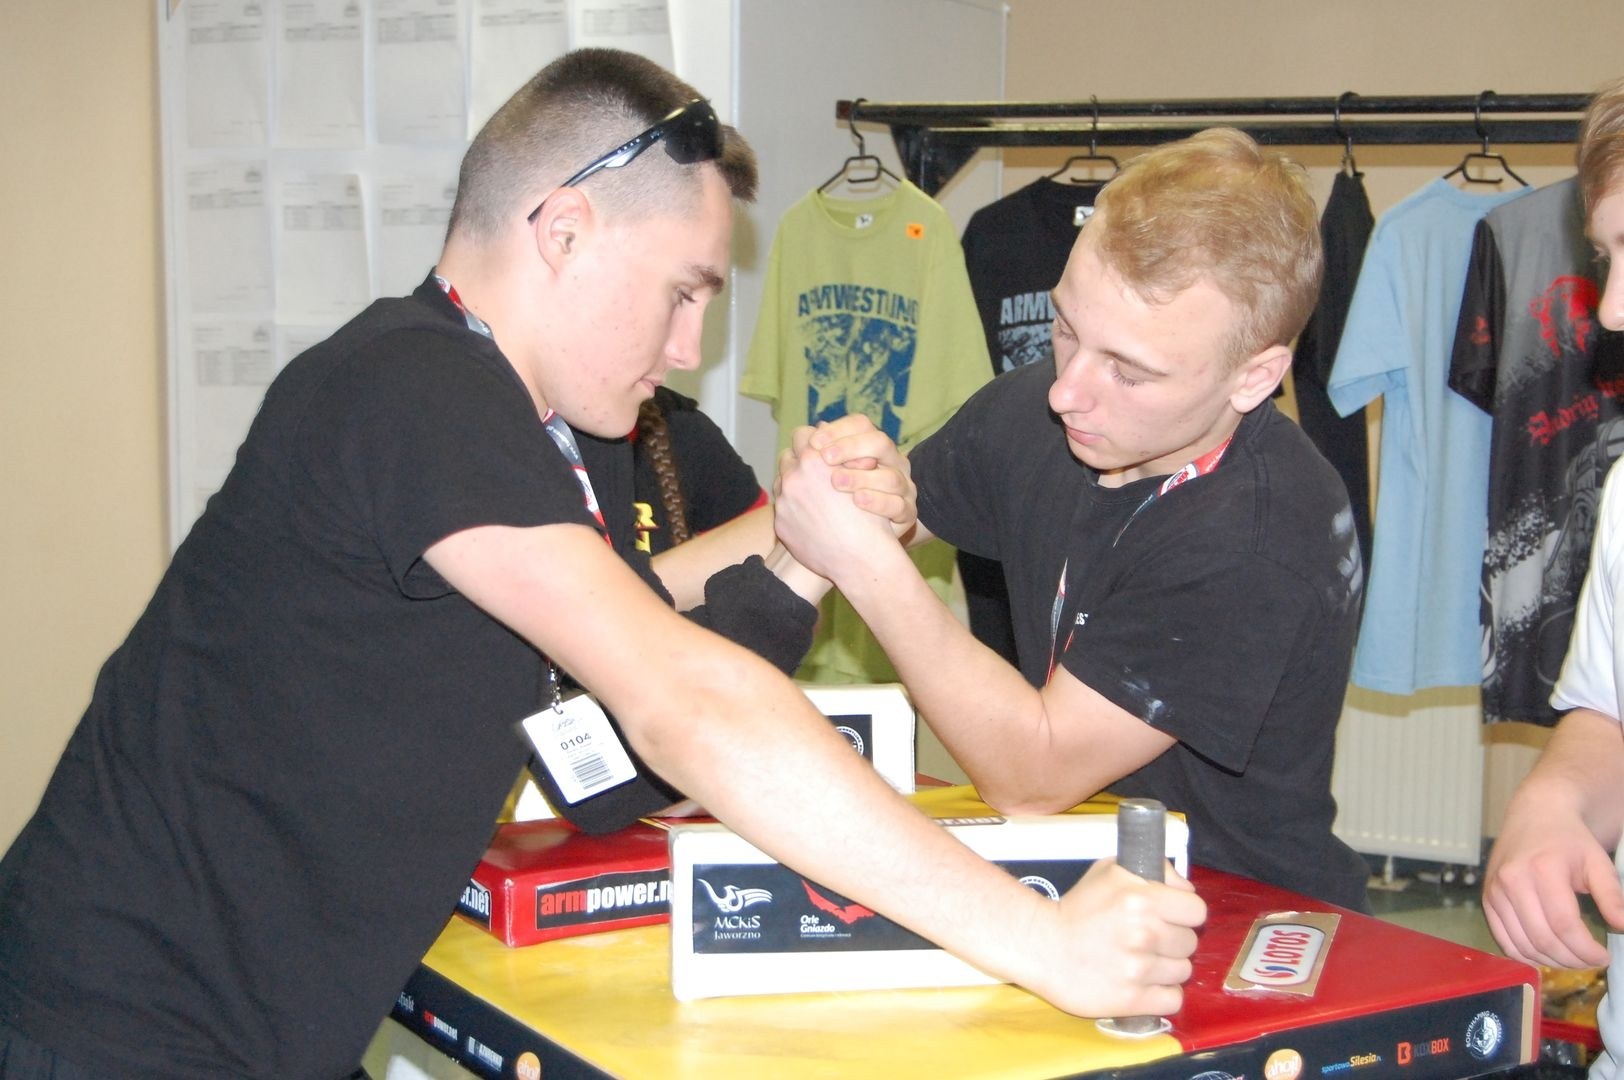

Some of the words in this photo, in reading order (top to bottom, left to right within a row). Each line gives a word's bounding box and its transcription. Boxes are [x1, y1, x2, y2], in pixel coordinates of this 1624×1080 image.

[560, 732, 592, 751] 0104
[540, 879, 673, 915] armpower.n
[800, 914, 820, 925] Orle
[714, 930, 761, 941] Jaworzno
[800, 923, 836, 933] Gniazdo
[1260, 929, 1311, 965] LOTOS
